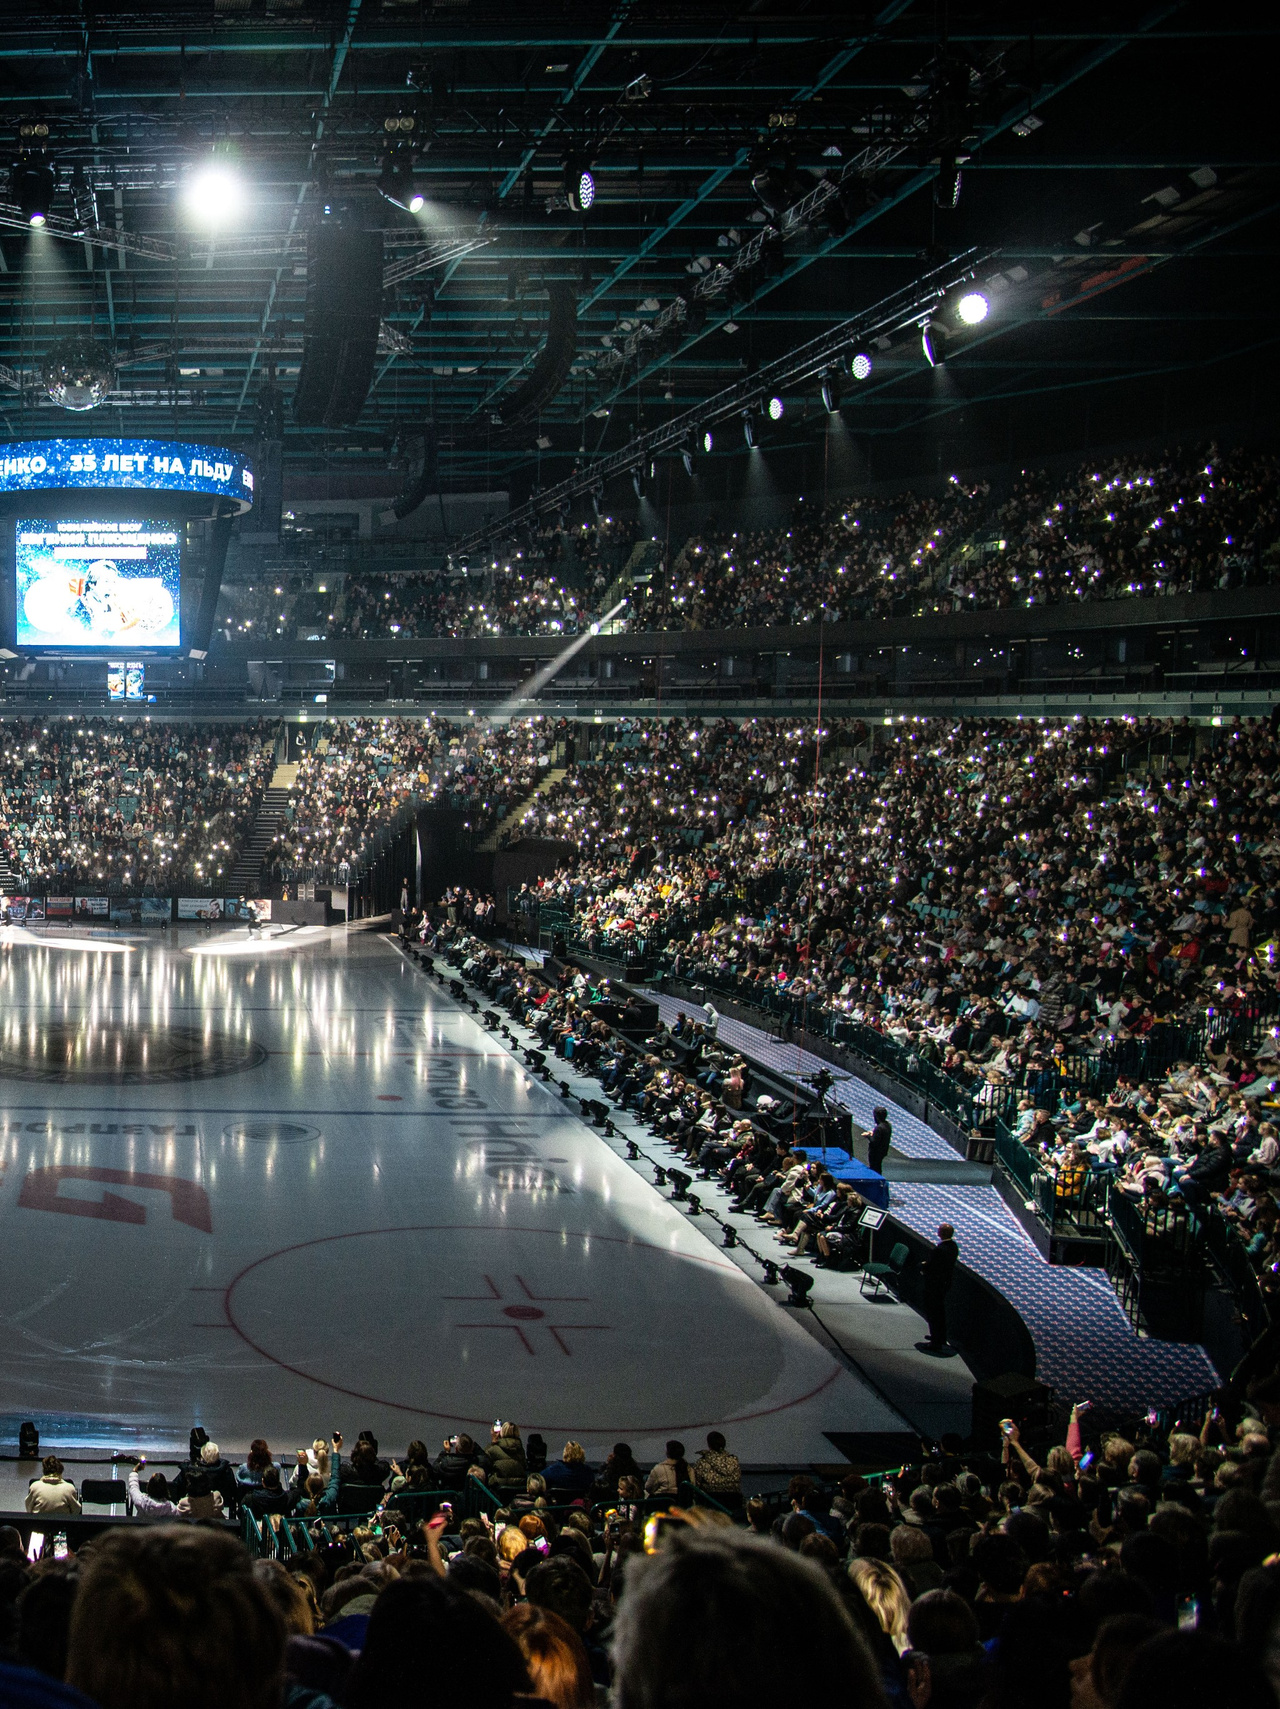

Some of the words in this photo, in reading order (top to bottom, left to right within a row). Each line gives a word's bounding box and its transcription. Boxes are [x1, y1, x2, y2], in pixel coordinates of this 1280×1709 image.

[70, 454, 97, 472] 35
[102, 454, 149, 472] ЛЕТ
[153, 456, 185, 474] НА
[189, 459, 234, 482] ЛЬДУ
